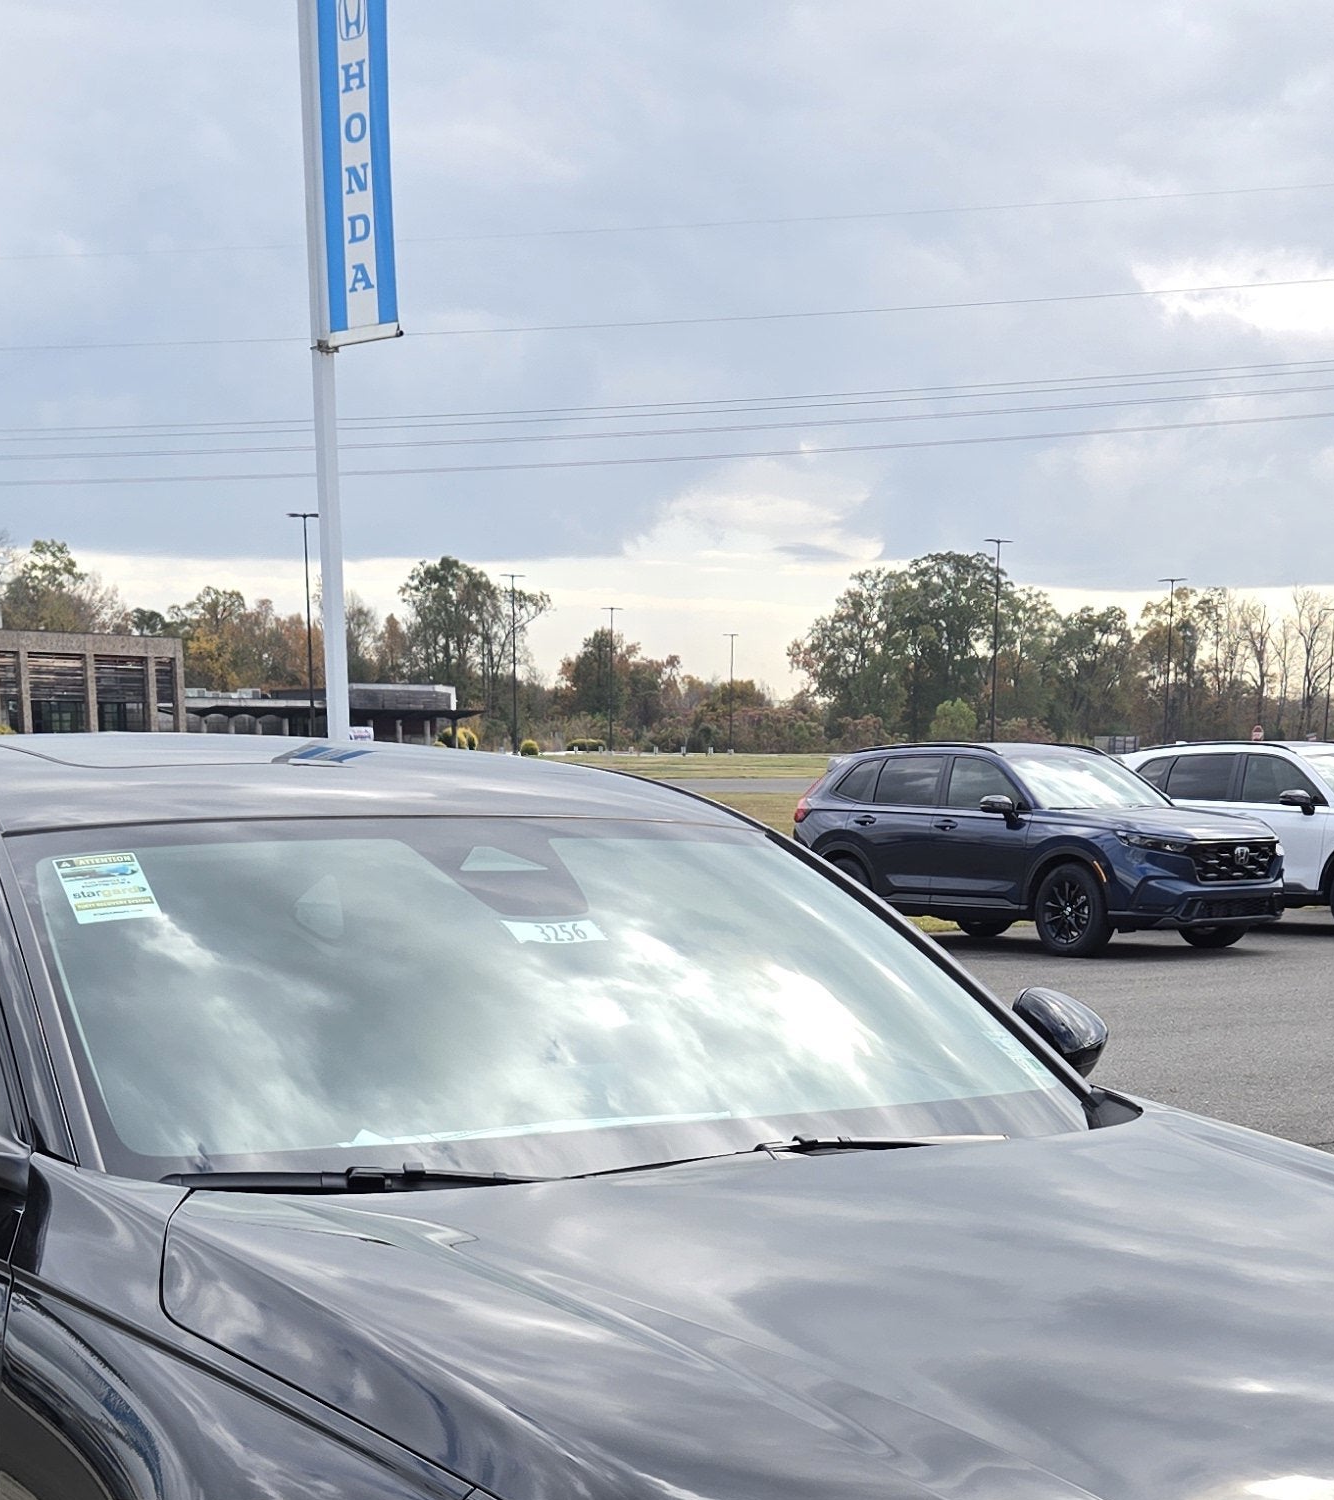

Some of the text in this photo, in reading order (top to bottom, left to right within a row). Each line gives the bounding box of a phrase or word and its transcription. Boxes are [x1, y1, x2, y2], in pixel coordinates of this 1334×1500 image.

[341, 58, 375, 293] HONDA
[78, 855, 131, 866] ATTENTION
[534, 923, 587, 942] 3256
